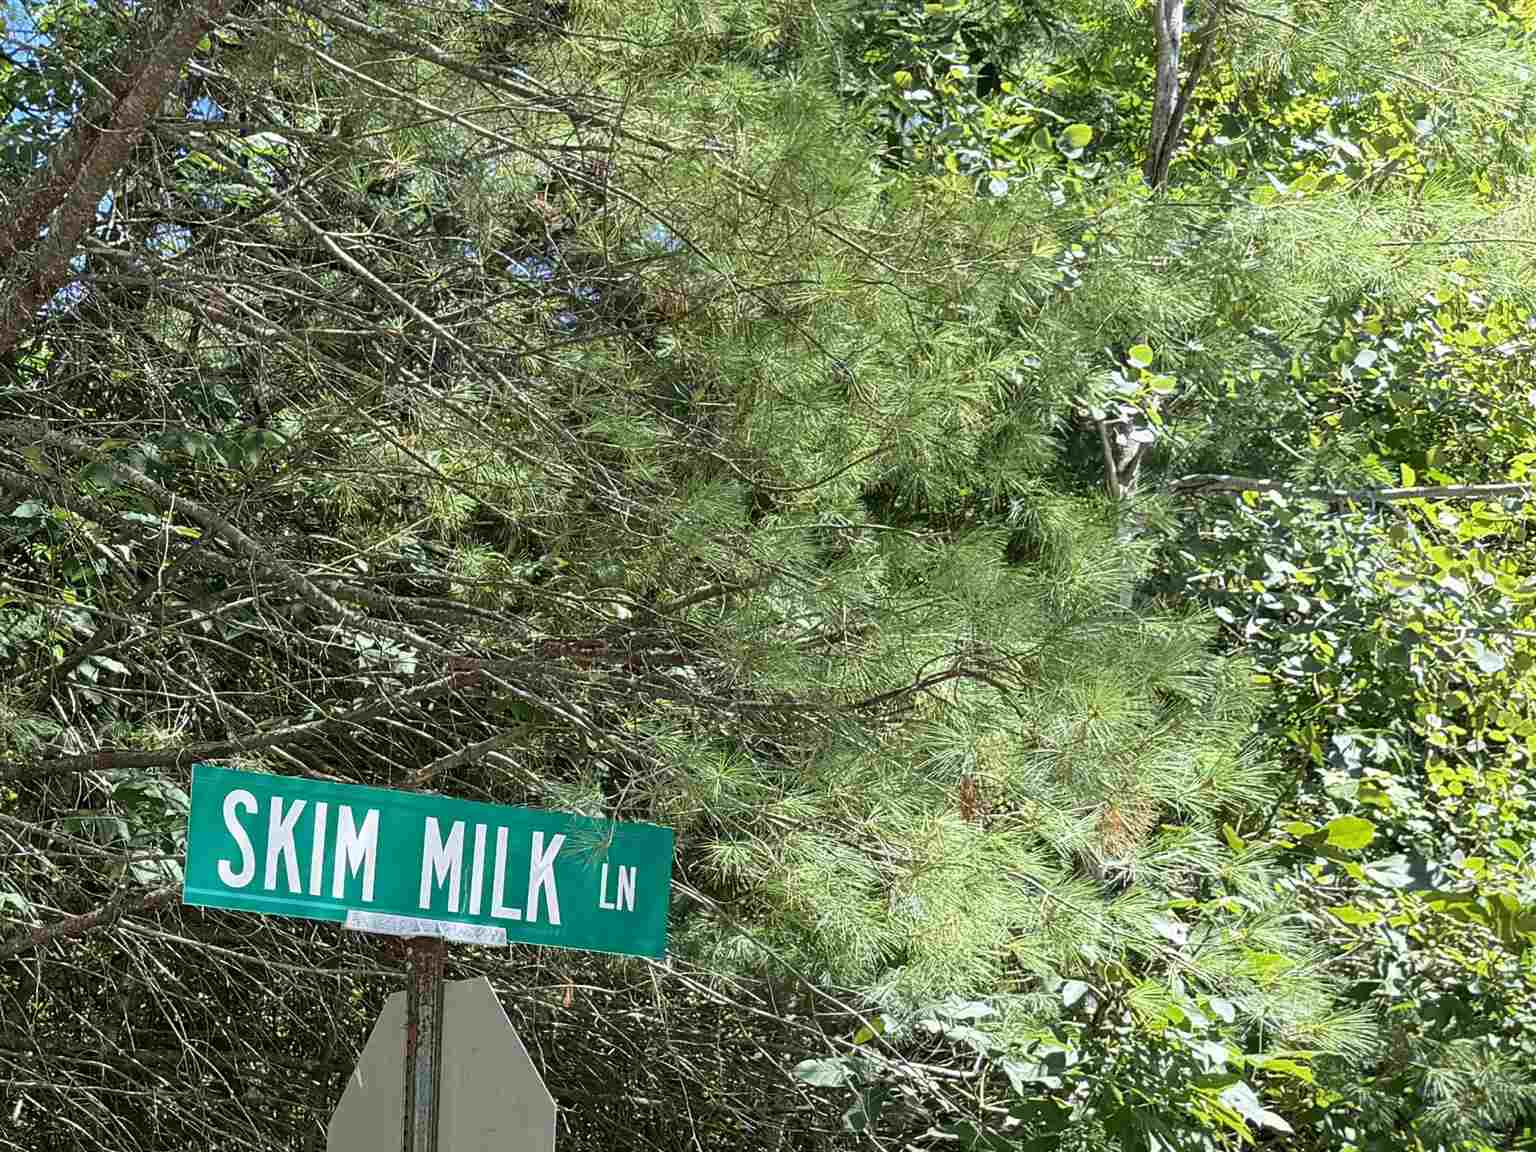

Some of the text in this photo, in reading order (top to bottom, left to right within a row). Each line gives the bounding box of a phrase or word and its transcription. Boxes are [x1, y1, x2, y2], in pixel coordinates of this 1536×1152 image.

[218, 790, 637, 925] SKIM MILK LN
